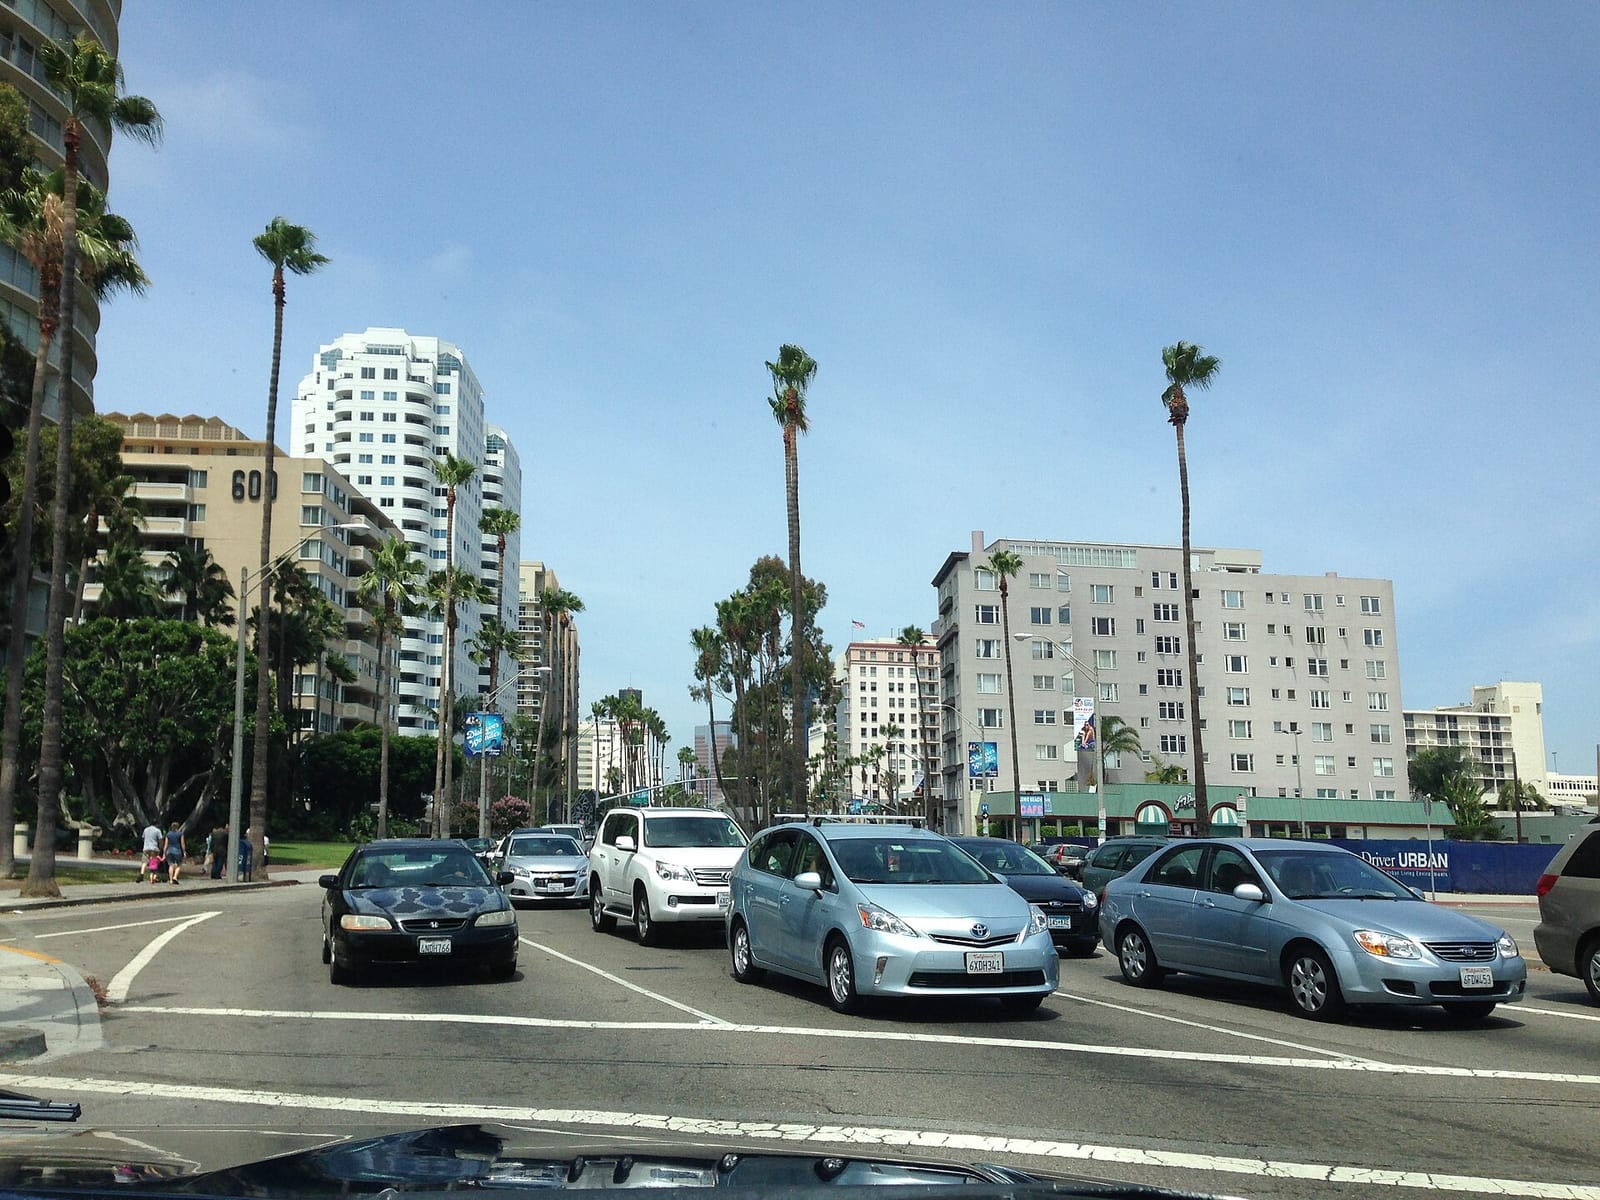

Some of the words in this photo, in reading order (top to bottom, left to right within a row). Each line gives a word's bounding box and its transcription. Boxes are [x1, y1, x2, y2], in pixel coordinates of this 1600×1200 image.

[1021, 804, 1043, 815] CAFE
[1361, 851, 1395, 867] Driver
[1398, 852, 1448, 868] URBAN
[970, 960, 1000, 972] 6XDH341
